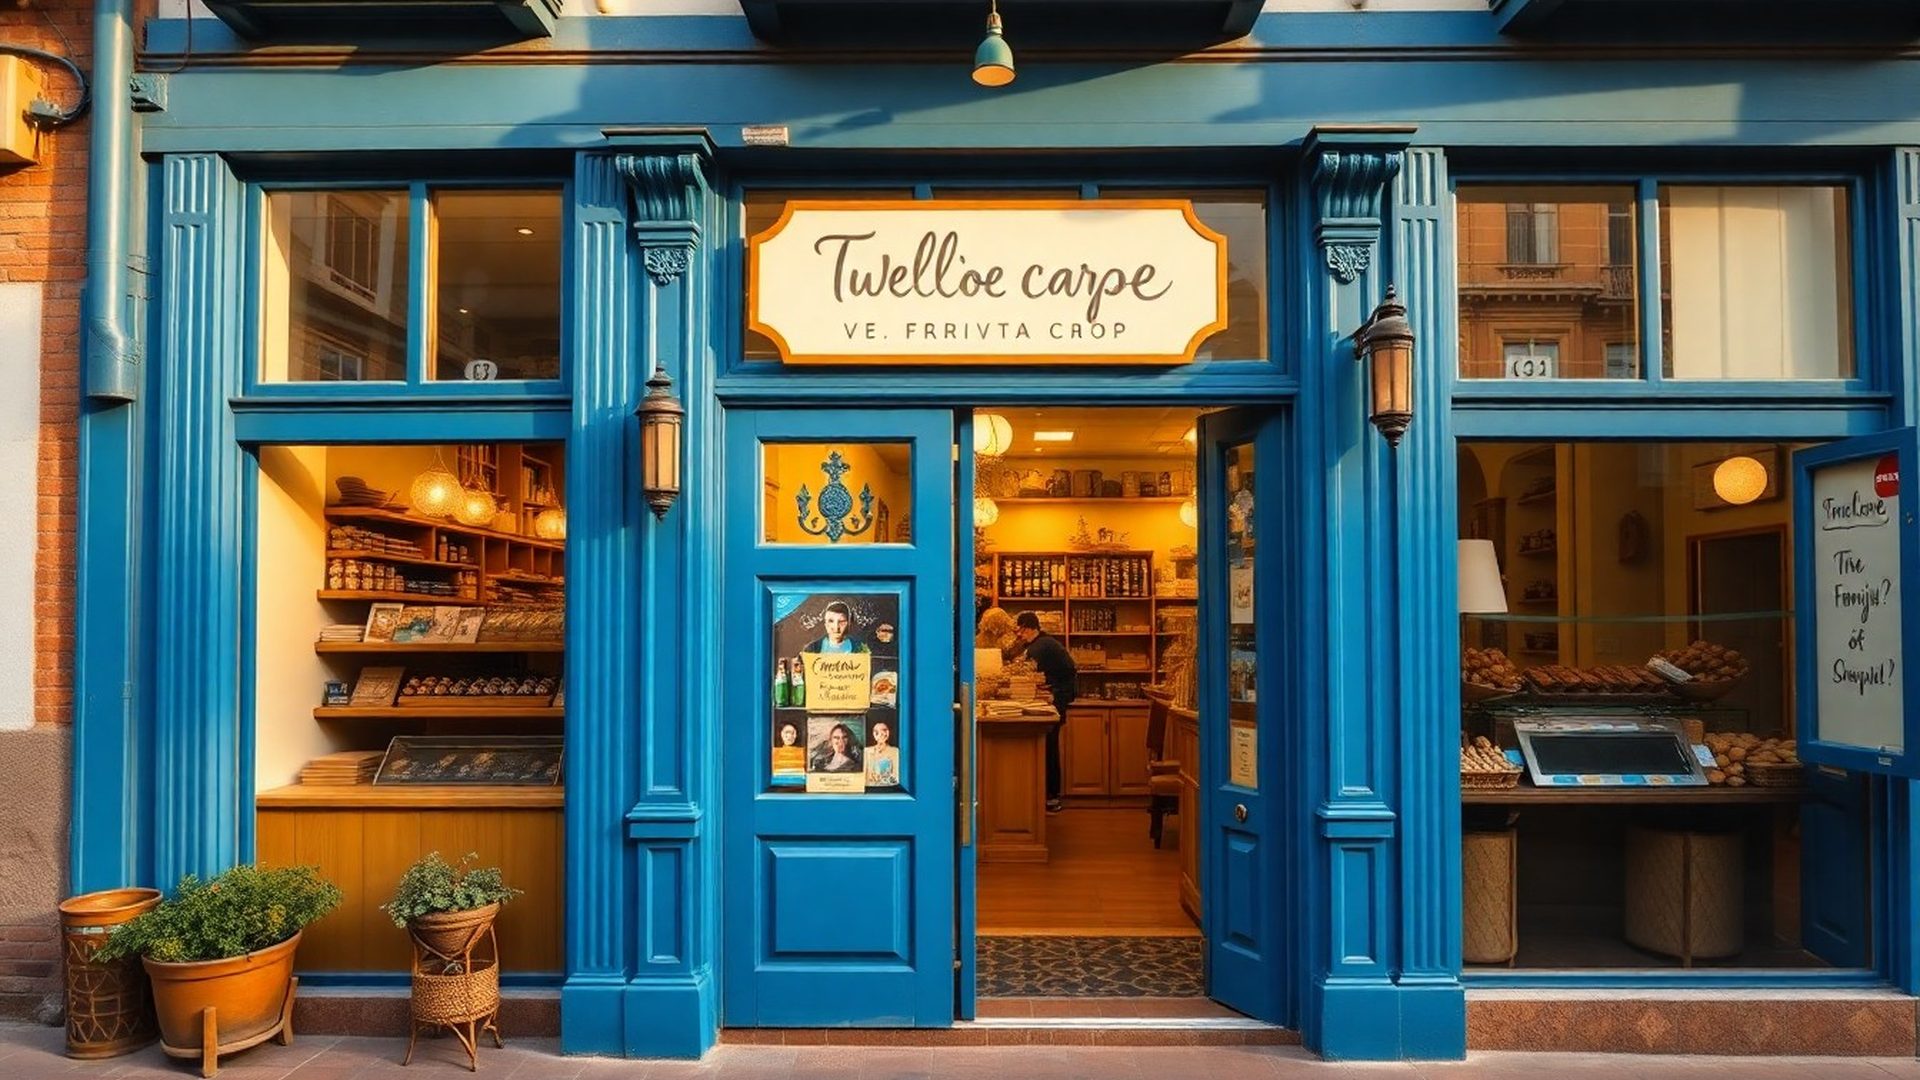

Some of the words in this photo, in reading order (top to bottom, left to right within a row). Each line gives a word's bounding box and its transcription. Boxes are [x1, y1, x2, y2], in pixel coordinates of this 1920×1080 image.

[1021, 262, 1174, 324] carpe
[843, 322, 889, 340] VE.
[905, 322, 1031, 340] FRRIVTA
